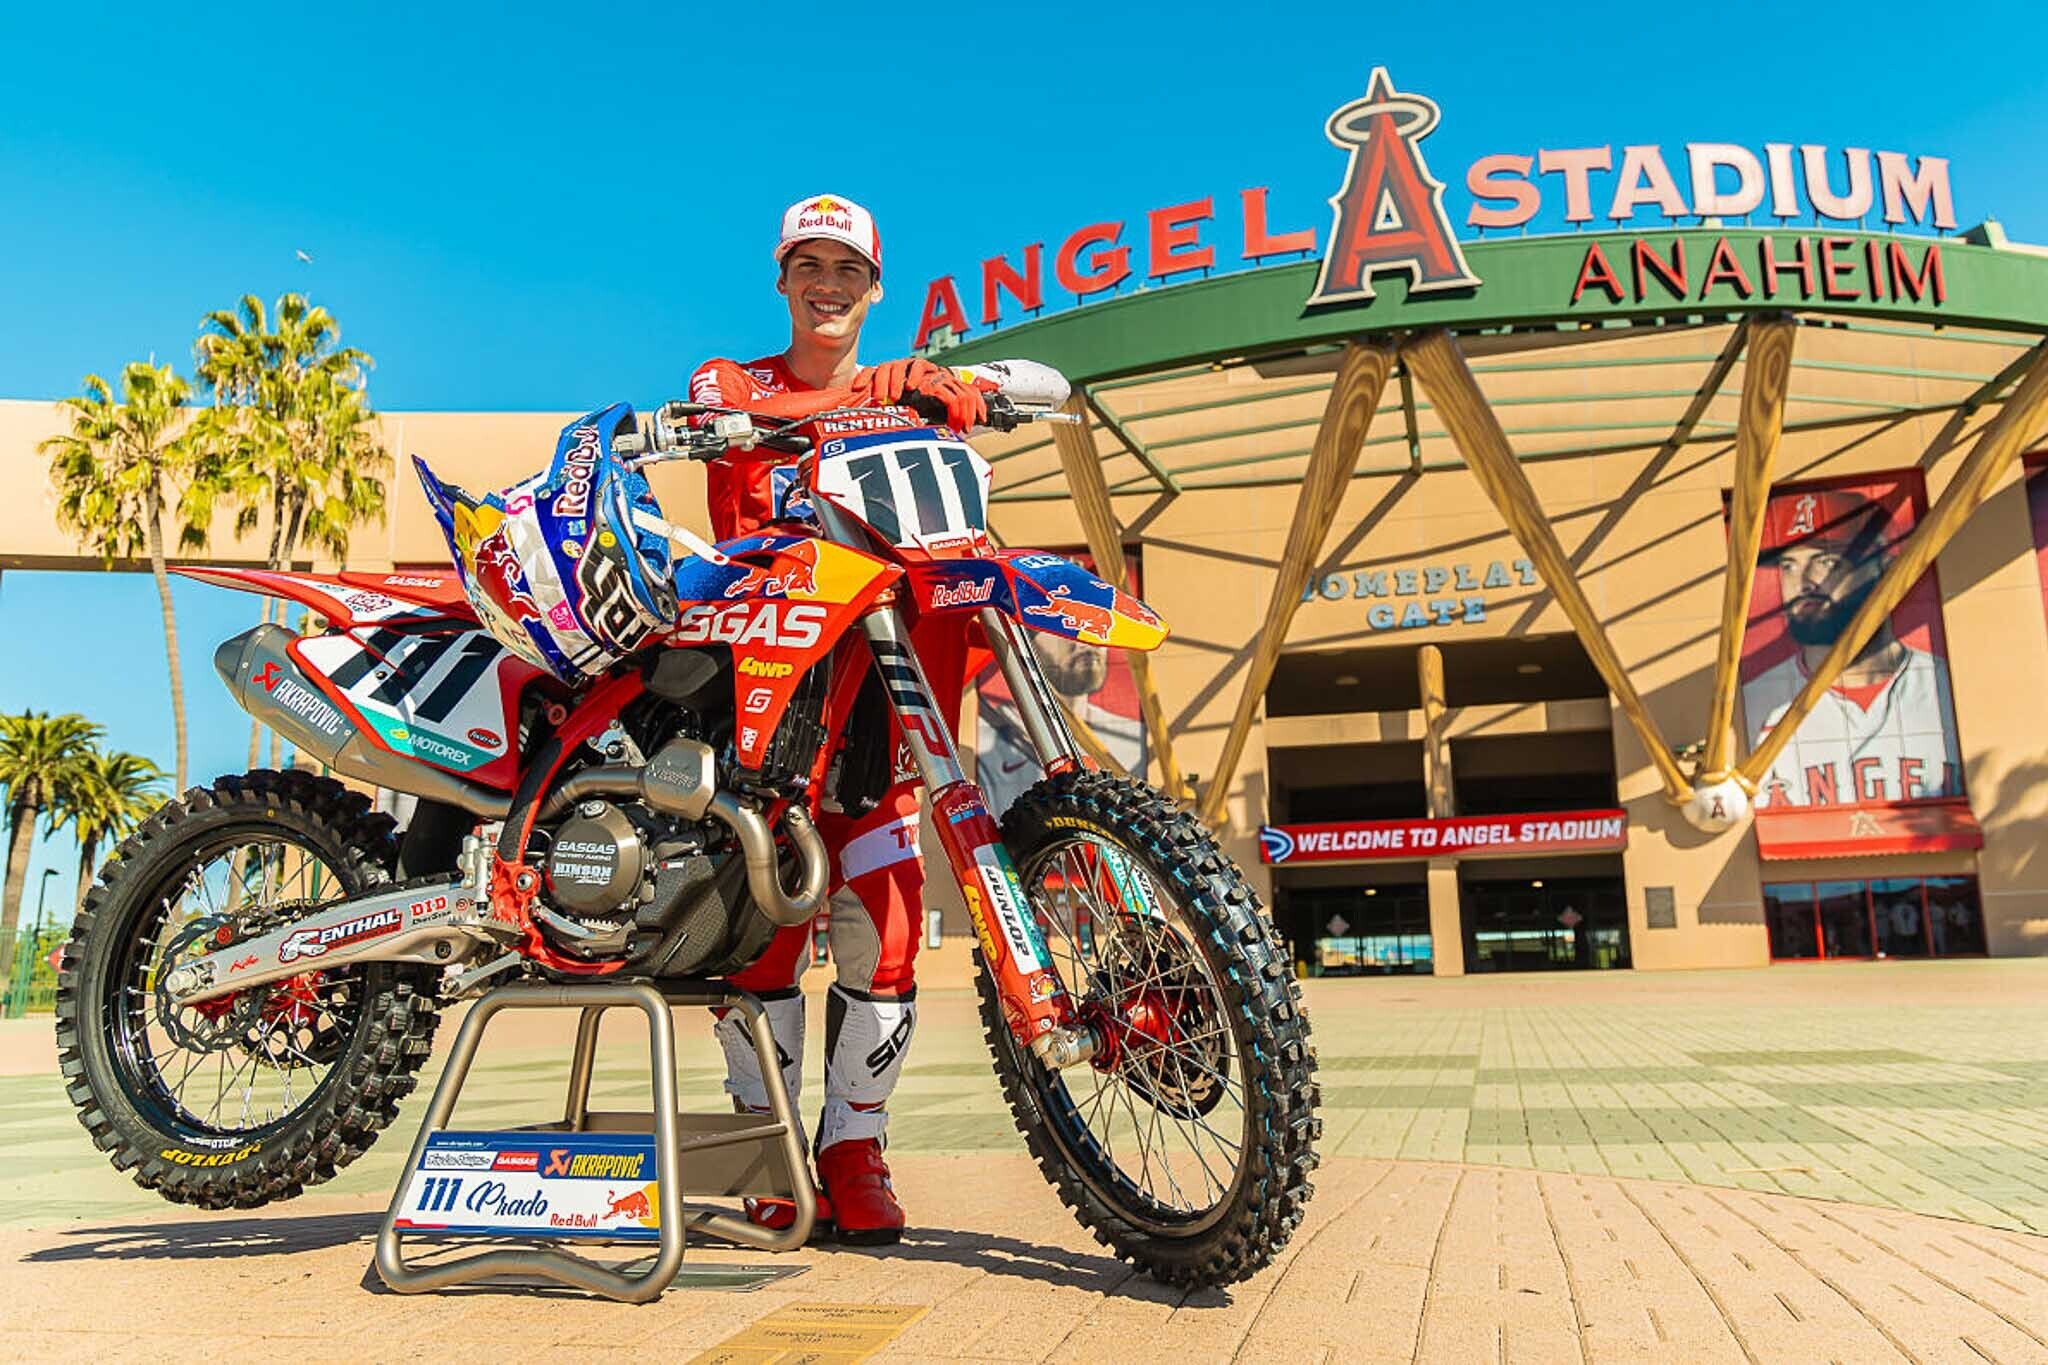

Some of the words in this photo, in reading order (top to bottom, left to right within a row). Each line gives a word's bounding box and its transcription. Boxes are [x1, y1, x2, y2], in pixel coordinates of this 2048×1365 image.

[1465, 142, 1957, 230] STADIUM
[798, 214, 823, 230] Red
[825, 215, 852, 232] Bull
[913, 186, 1317, 350] ANGEL
[1572, 235, 1947, 303] ANAHEIM
[552, 461, 593, 517] Red
[847, 447, 987, 547] 111
[931, 584, 964, 607] Red
[961, 577, 996, 604] Bull
[1301, 560, 1537, 602] OMEPLAT
[677, 602, 828, 649] SGAS
[1366, 597, 1487, 632] GATE
[407, 733, 472, 766] MOTOREX
[556, 841, 617, 855] GASGAS
[1298, 828, 1404, 853] WELCOME
[1409, 826, 1438, 848] TO
[1441, 824, 1516, 846] ANGEL
[1519, 818, 1622, 843] STADIUM
[985, 866, 1031, 956] DUNLOP
[416, 1177, 463, 1211] 111
[467, 1180, 548, 1217] Prado
[550, 1213, 574, 1227] Red
[574, 1213, 598, 1228] Bull
